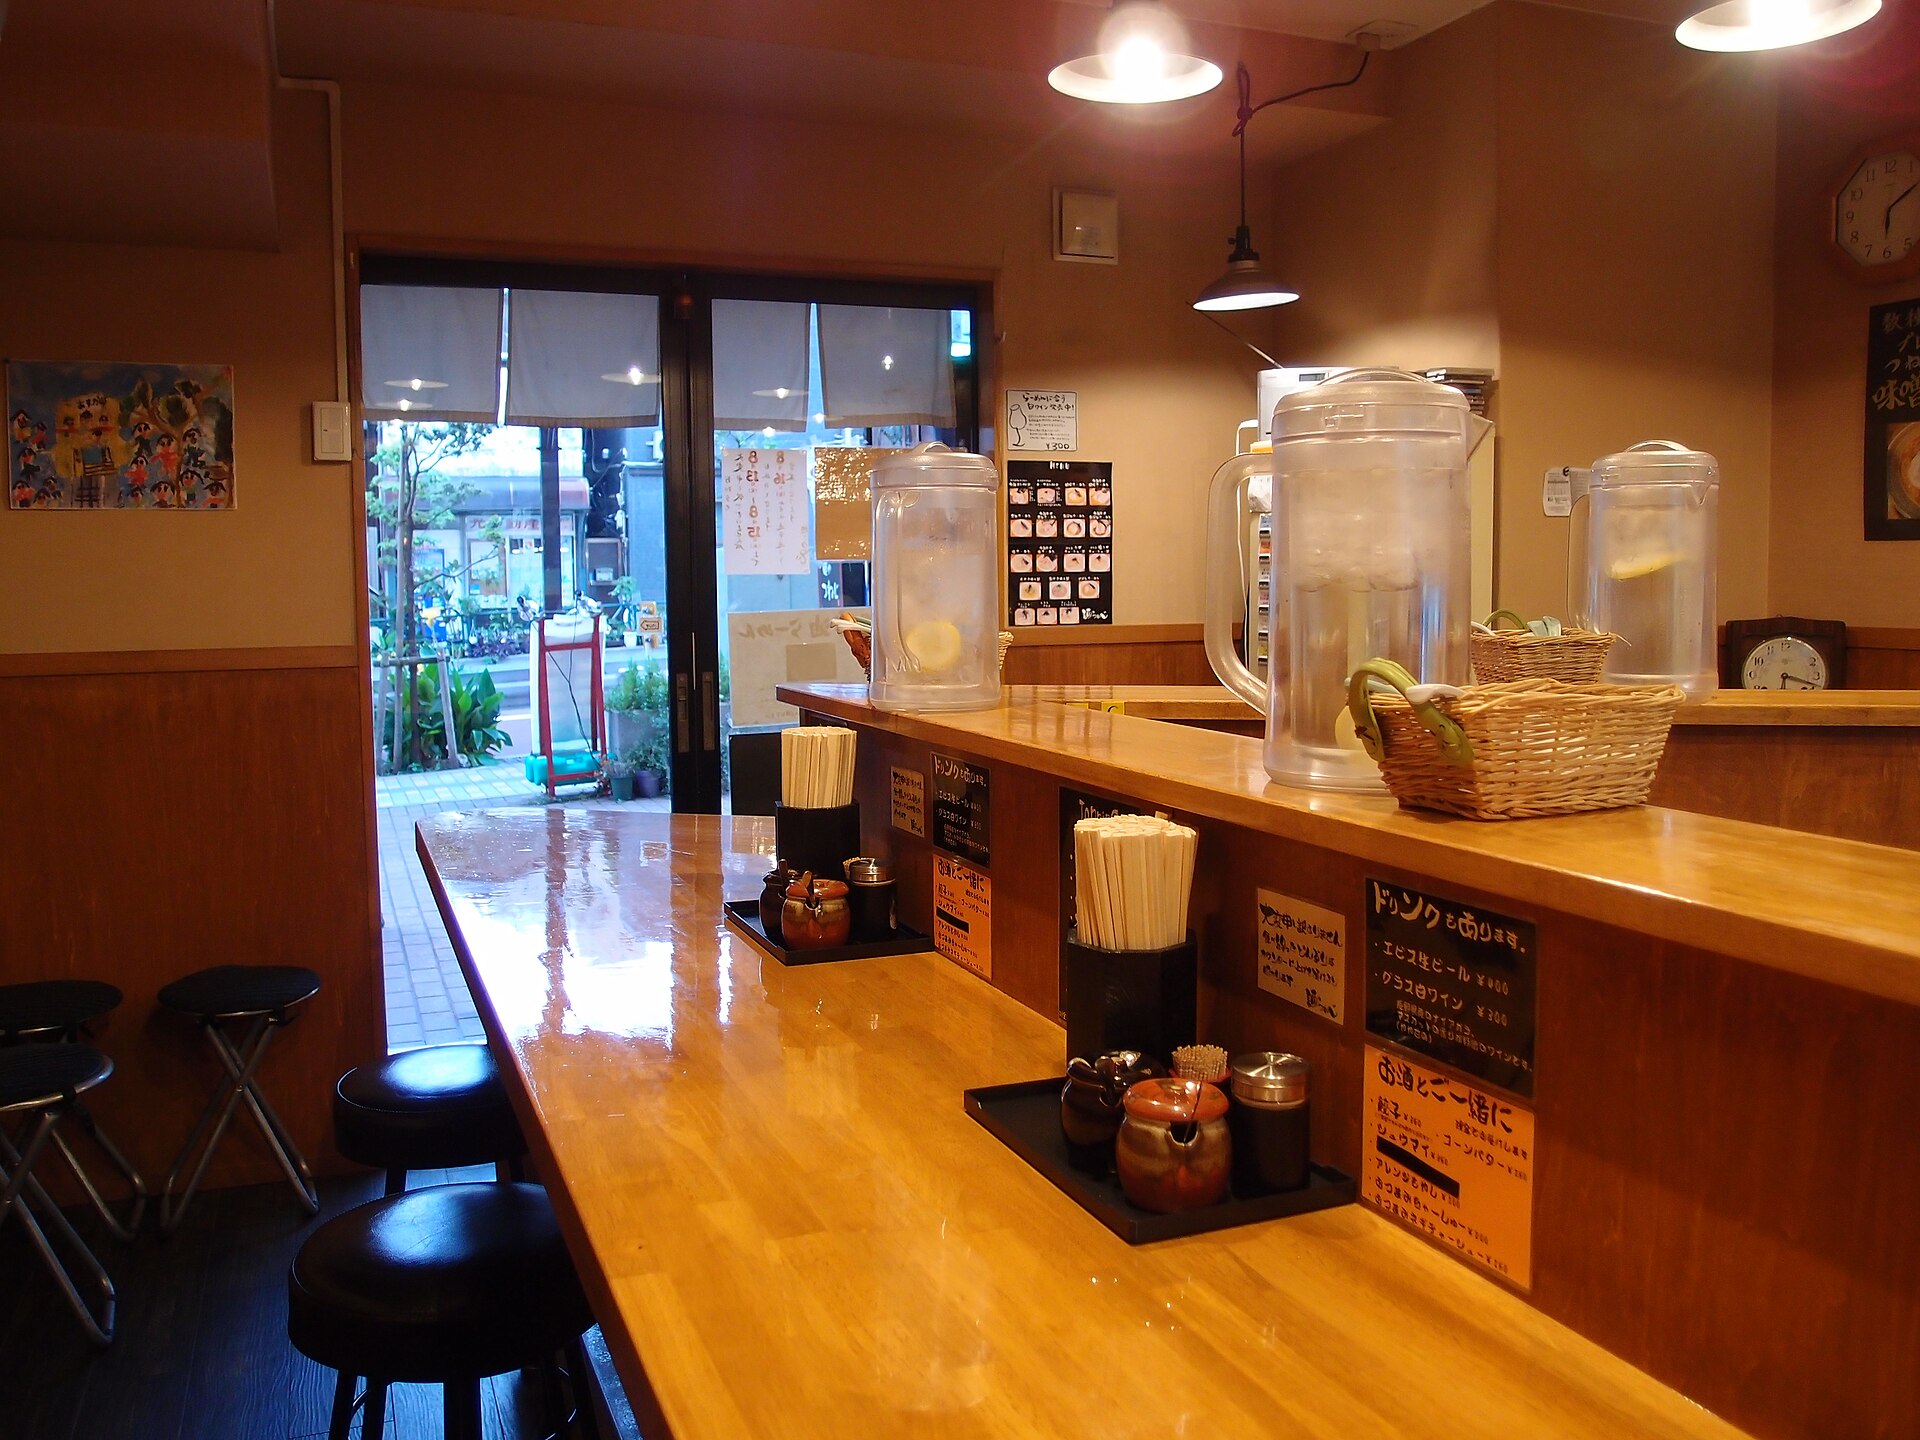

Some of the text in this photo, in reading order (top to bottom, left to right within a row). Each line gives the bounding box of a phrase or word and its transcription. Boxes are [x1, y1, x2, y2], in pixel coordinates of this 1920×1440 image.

[1885, 160, 1897, 174] 12
[1866, 168, 1875, 182] 11
[1851, 188, 1863, 201] 10
[1846, 211, 1854, 223] 9
[1850, 231, 1858, 243] 8
[1904, 237, 1912, 251] 5
[1865, 244, 1872, 257] 7
[1883, 246, 1891, 259] 6
[1383, 940, 1509, 996] エビス生ビール ¥400
[1382, 971, 1507, 1027] グラス白ワイン ¥300
[1378, 1055, 1512, 1133] お酒とご一緒に
[1377, 1124, 1430, 1158] シュウマイ
[1443, 1134, 1505, 1169] コーンバター
